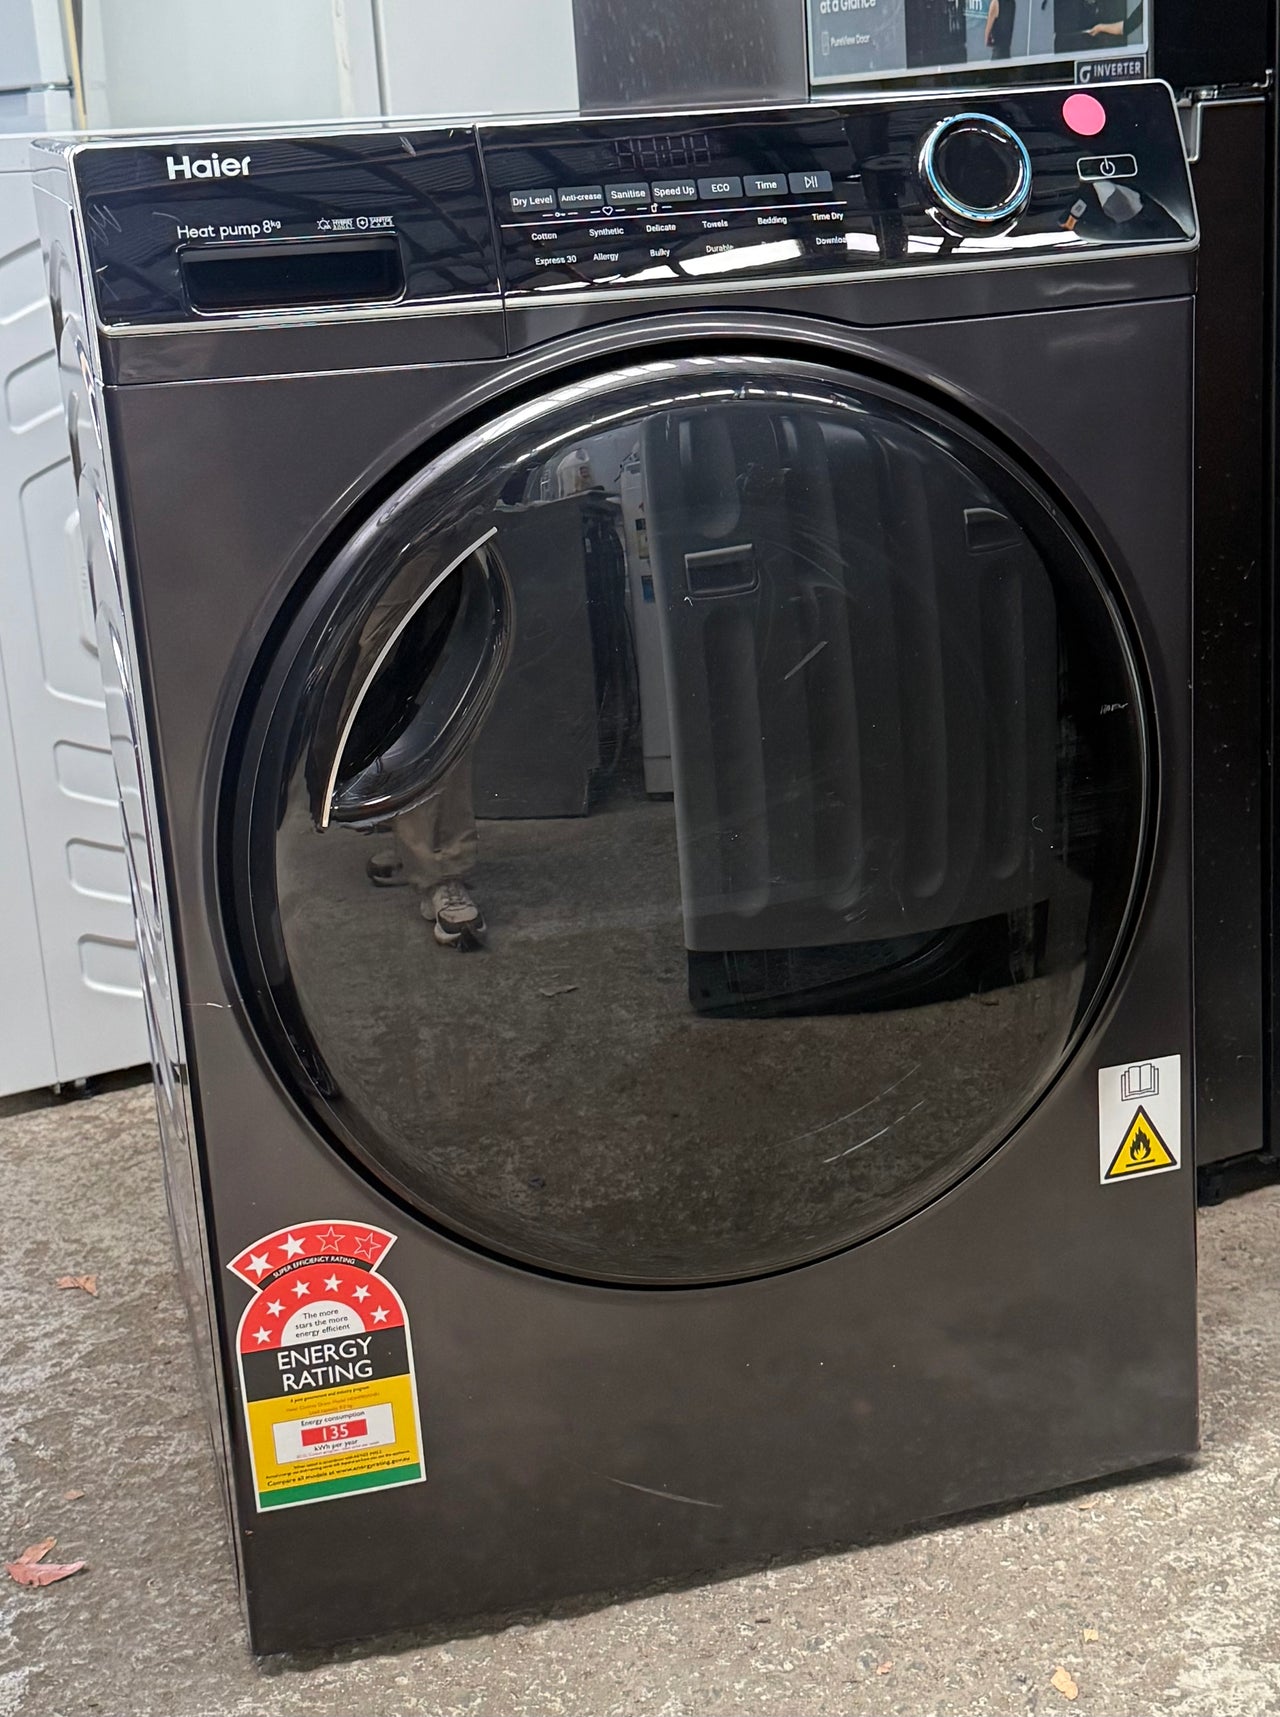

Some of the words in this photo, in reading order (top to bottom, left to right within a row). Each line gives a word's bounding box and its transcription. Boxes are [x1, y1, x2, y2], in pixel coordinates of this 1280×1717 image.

[832, 0, 839, 12] a
[1093, 61, 1141, 77] INVERTER
[166, 152, 251, 180] Haier
[711, 183, 730, 192] ECO
[755, 180, 777, 190] Time
[561, 192, 602, 202] Anti-crease
[611, 189, 646, 199] Sanitise
[654, 186, 681, 198] Speed
[682, 185, 695, 196] Up
[512, 198, 527, 207] Dry
[529, 195, 553, 205] Level
[757, 216, 788, 225] Bedding
[811, 213, 830, 221] Time
[831, 212, 844, 221] Dry
[646, 224, 676, 232] Delicate
[702, 219, 729, 228] Towels
[177, 225, 214, 239] Heat
[219, 223, 260, 240] pump
[531, 232, 558, 241] Cotton
[589, 227, 624, 237] Synthetic
[593, 252, 619, 261] Allergy
[650, 248, 671, 257] Bulky
[535, 256, 566, 266] Express
[566, 255, 577, 263] 30
[273, 1265, 292, 1278] SUPER
[293, 1256, 329, 1268] EFFICIENCY
[331, 1256, 355, 1265] RATING
[303, 1312, 318, 1320] The
[319, 1309, 339, 1317] more
[295, 1321, 312, 1330] stars
[314, 1318, 327, 1326] the
[328, 1317, 348, 1325] more
[295, 1329, 320, 1339] energy
[322, 1324, 350, 1334] efficient
[277, 1336, 372, 1370] ENERGY
[282, 1360, 373, 1392] RATING
[301, 1418, 323, 1427] Energy
[324, 1411, 366, 1422] consumption
[322, 1424, 349, 1442] 135
[314, 1443, 331, 1451] kWh
[332, 1442, 342, 1450] per
[267, 1478, 296, 1487] Compare
